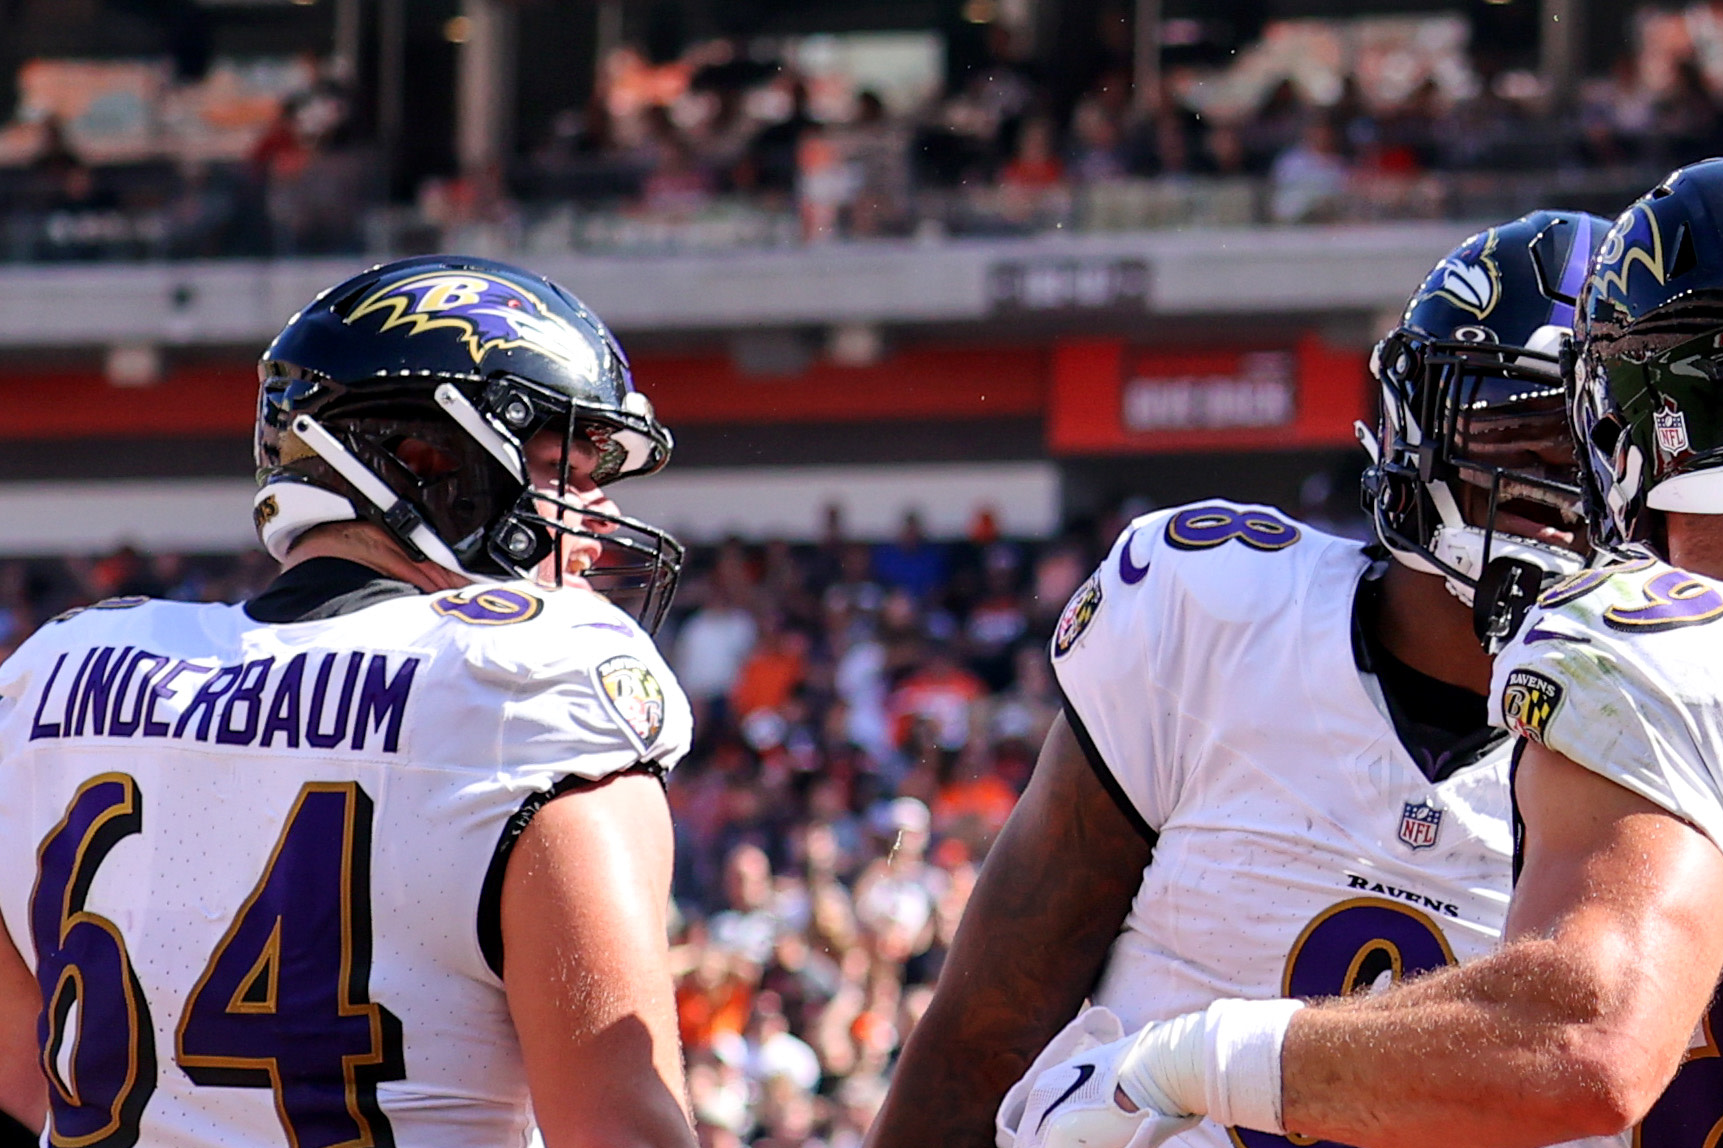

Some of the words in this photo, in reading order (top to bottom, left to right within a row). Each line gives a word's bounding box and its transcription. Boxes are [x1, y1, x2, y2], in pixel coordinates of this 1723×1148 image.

[395, 276, 489, 313] B
[1660, 425, 1685, 447] NFL
[1164, 506, 1302, 552] 8
[29, 646, 420, 754] LINDERBAUM
[1509, 672, 1557, 699] RAVENS
[1402, 819, 1433, 844] NFL
[1347, 874, 1460, 918] RAVENS
